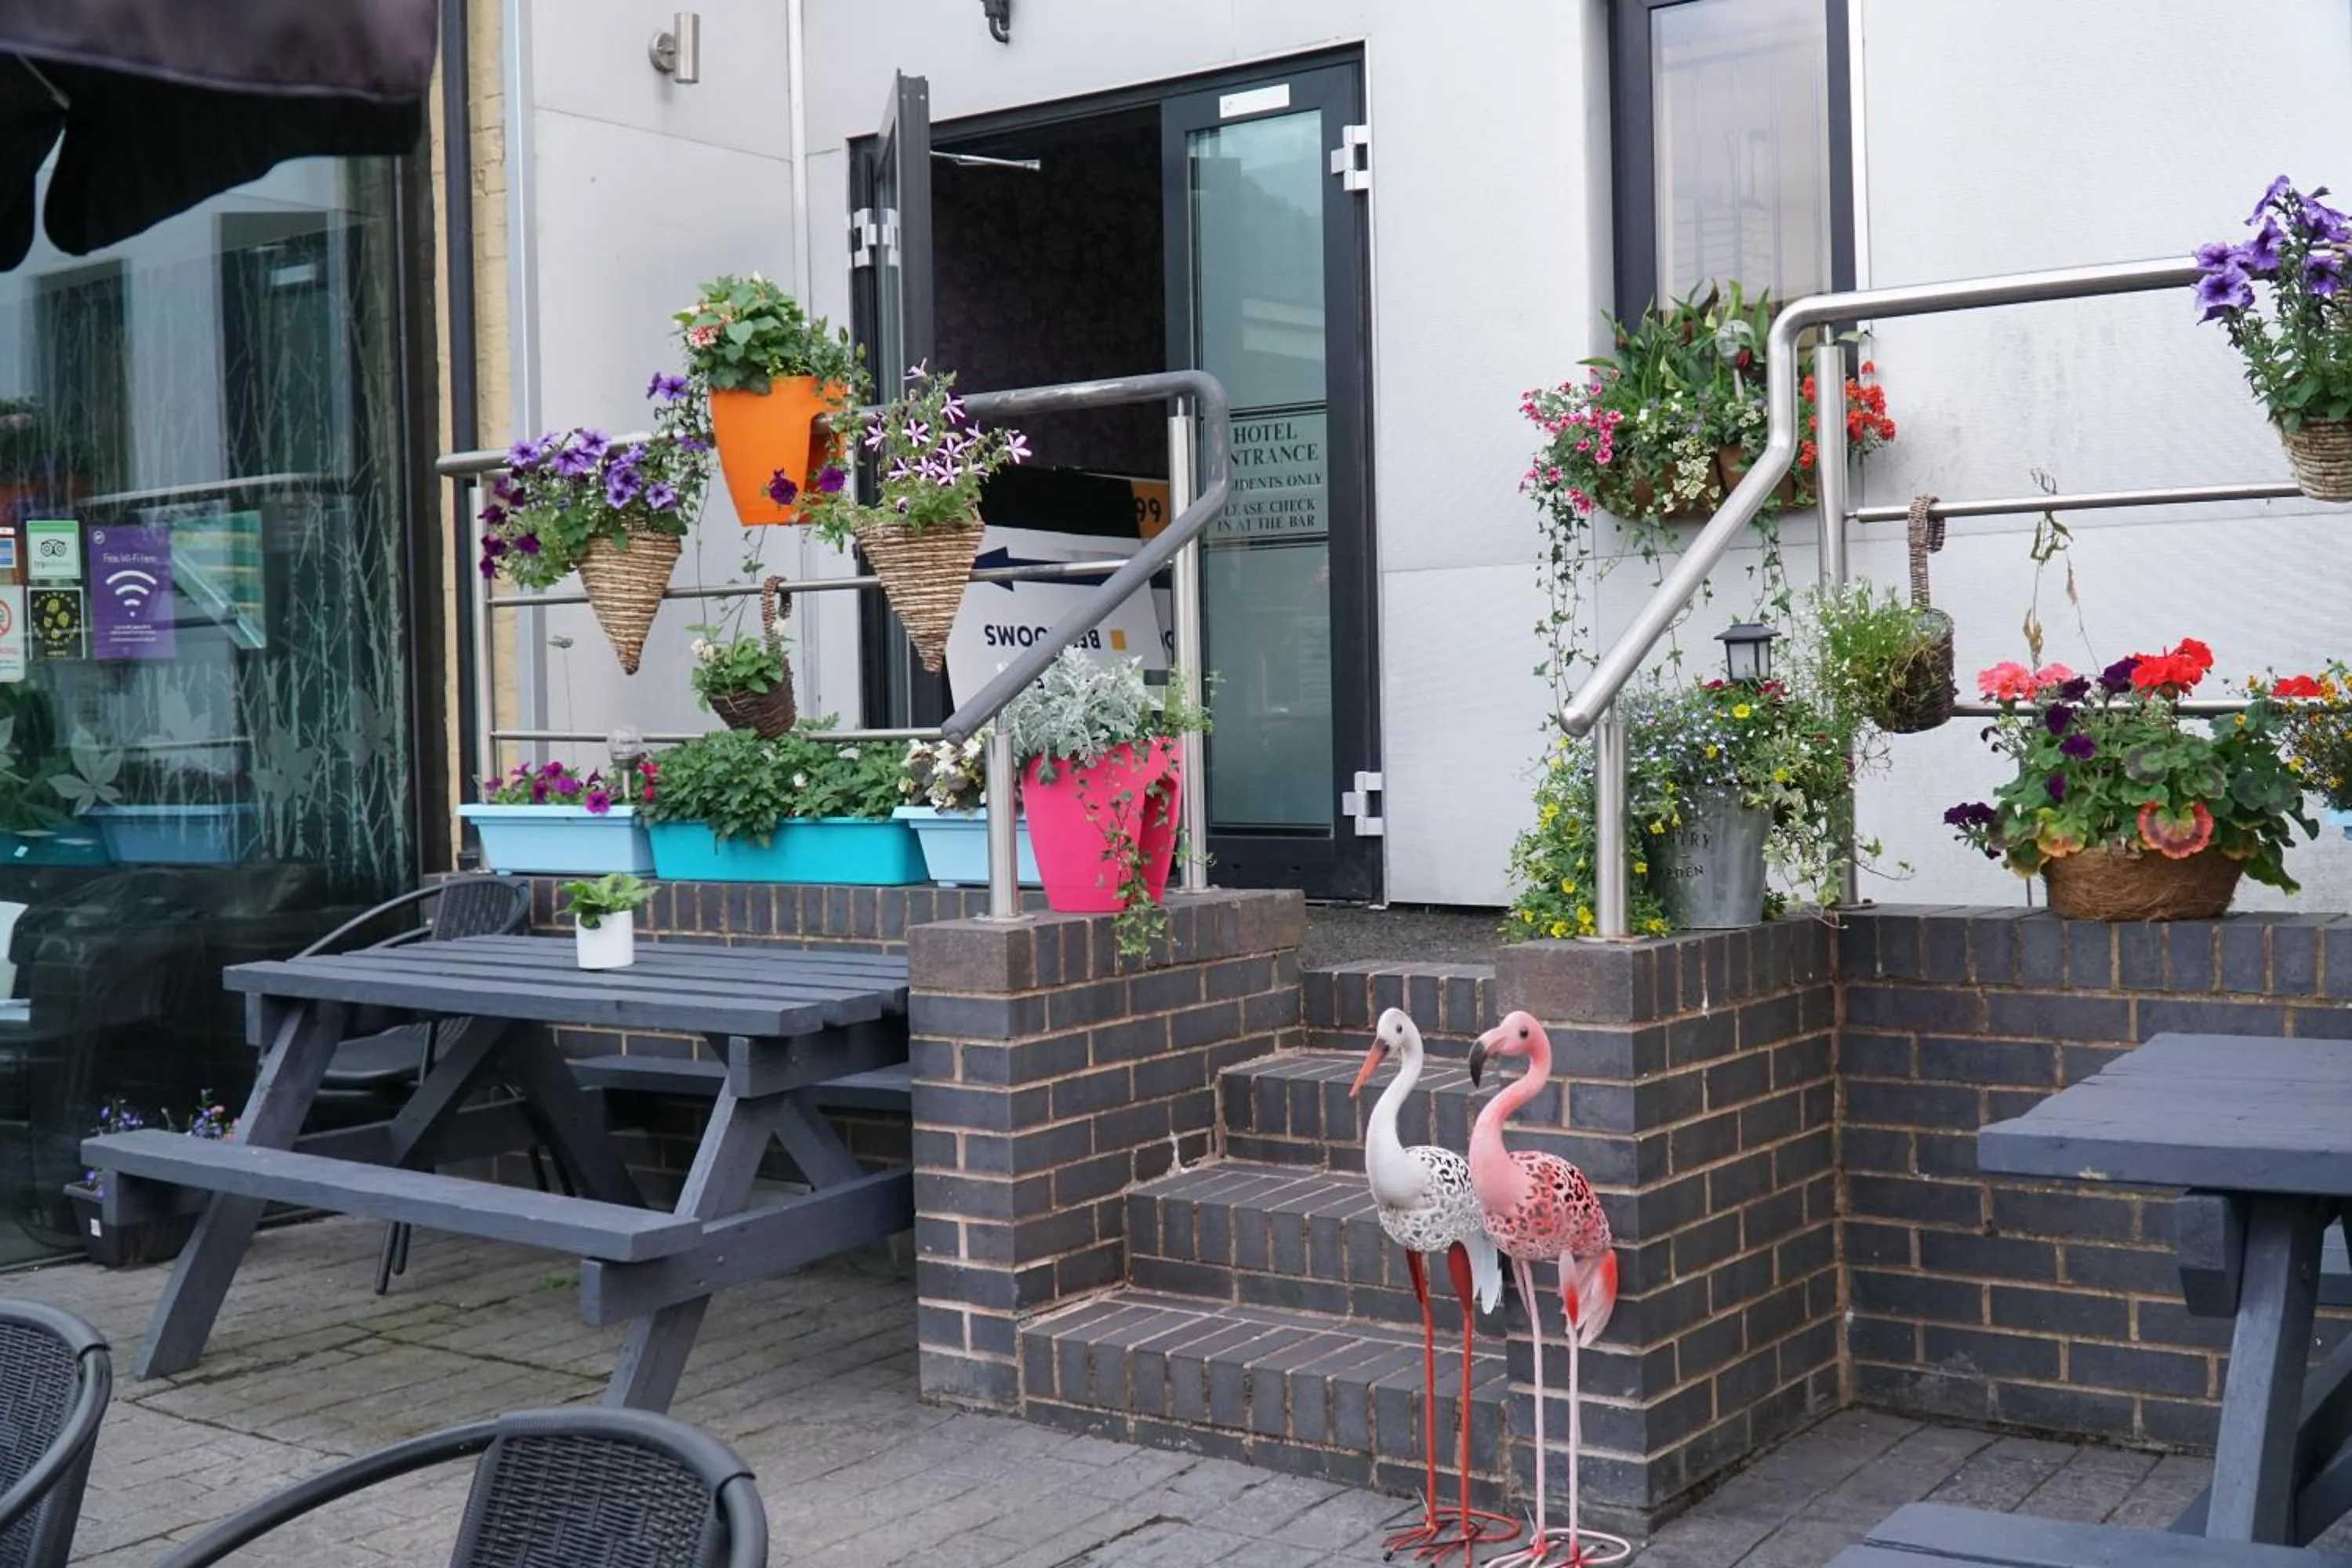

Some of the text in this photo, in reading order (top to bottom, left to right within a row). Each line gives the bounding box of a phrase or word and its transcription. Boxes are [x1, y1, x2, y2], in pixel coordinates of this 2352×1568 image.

[1233, 422, 1298, 444] HOTEL
[1230, 443, 1319, 466] NTRANCE
[1232, 472, 1323, 491] IDENTS ONLY
[1224, 497, 1316, 517] LEASE CHECK
[1218, 514, 1316, 532] IN AT THE BAR
[984, 624, 1102, 651] BEOOMS
